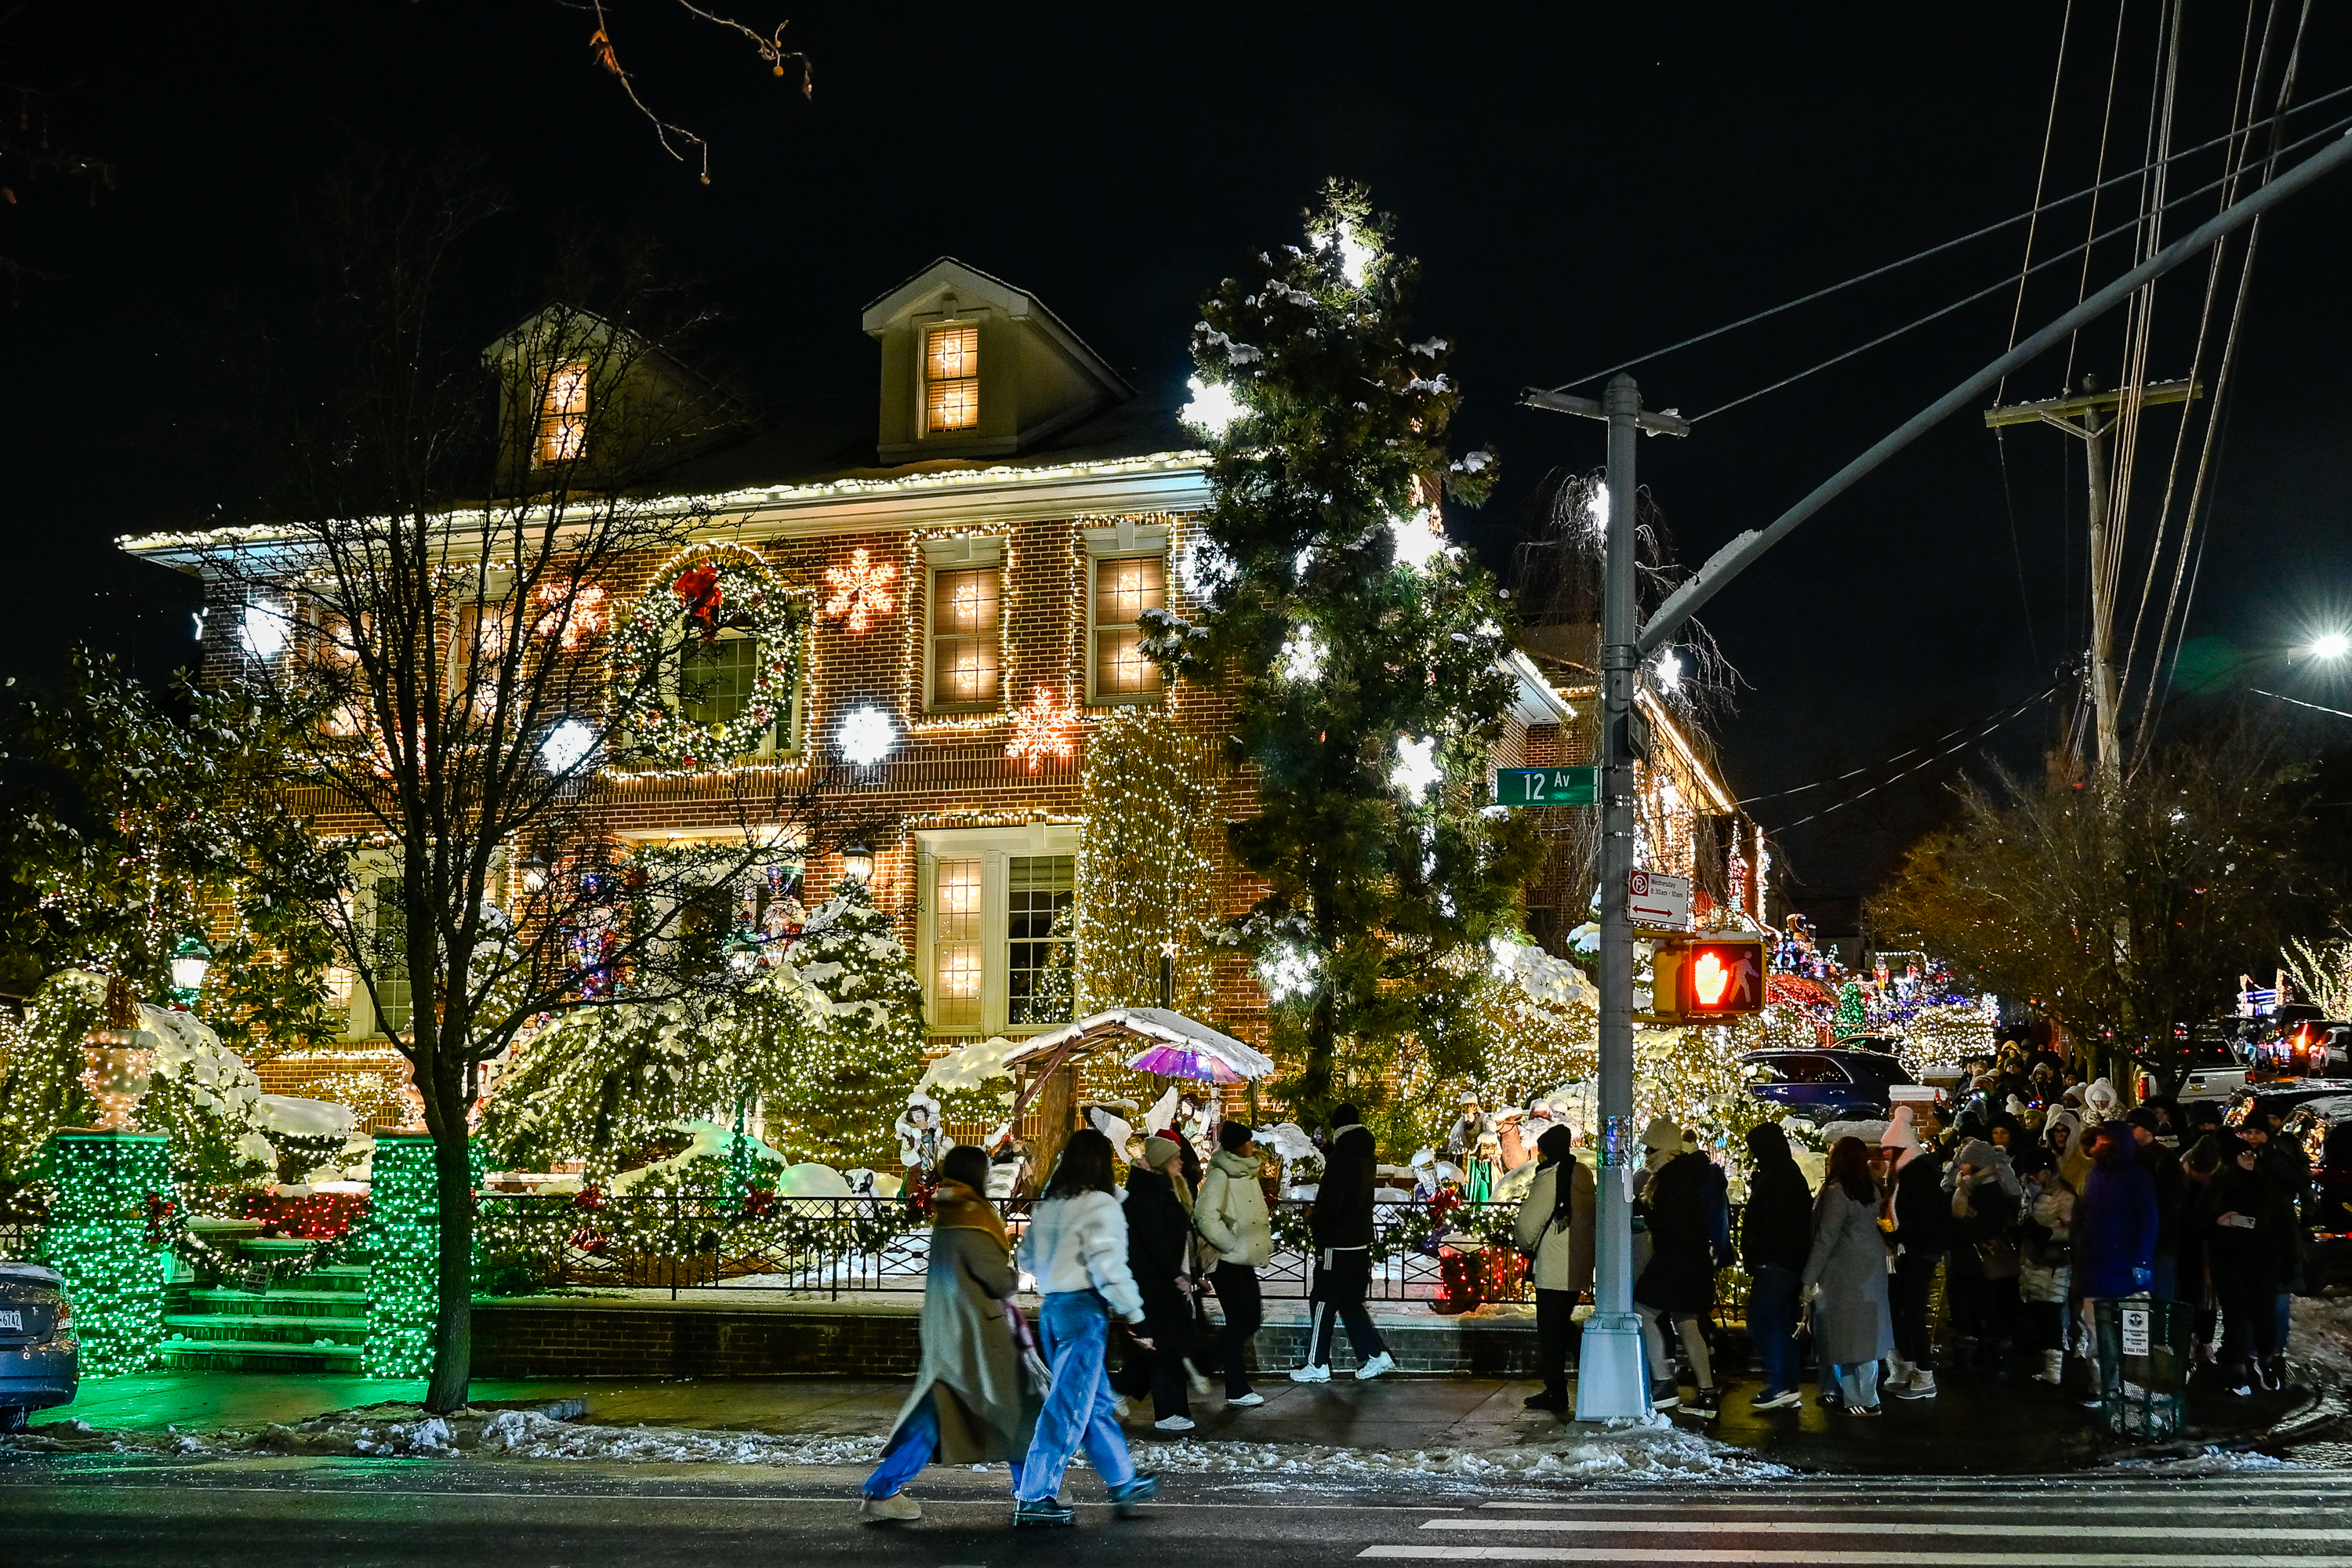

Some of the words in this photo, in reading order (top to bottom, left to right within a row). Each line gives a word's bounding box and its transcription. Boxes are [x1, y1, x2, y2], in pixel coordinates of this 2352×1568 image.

[1524, 773, 1545, 800] 12
[1554, 771, 1570, 787] Av
[1651, 879, 1675, 889] Wednesday
